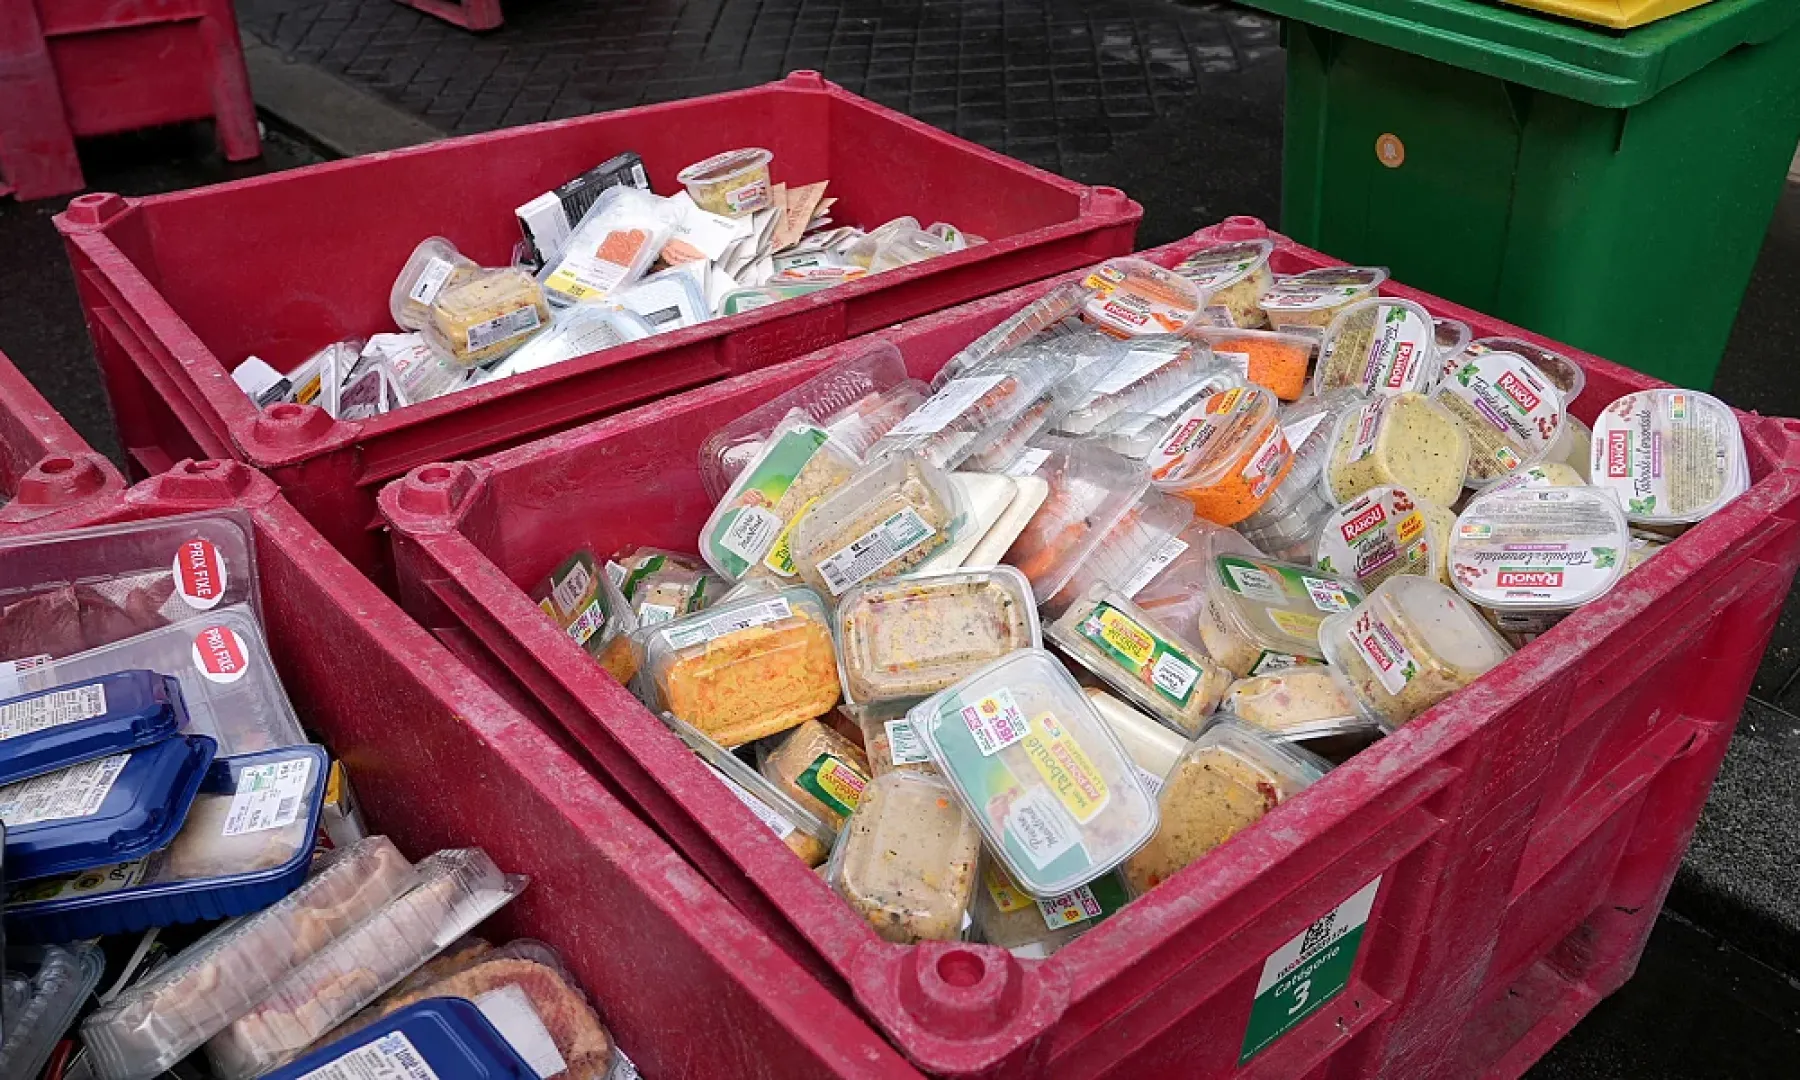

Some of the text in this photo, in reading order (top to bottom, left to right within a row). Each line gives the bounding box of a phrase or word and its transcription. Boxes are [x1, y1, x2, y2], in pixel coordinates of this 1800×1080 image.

[1390, 344, 1412, 385] RANOU
[1501, 374, 1537, 408] RANOU
[1611, 433, 1626, 474] RANOU
[1344, 506, 1382, 539] RANOU
[189, 541, 211, 596] PRIX FIXE
[1501, 573, 1558, 586] RANOU
[204, 628, 235, 672] PRIX FIXE
[1025, 738, 1072, 796] Taboulé
[1274, 946, 1340, 998] Catégorie
[1288, 978, 1312, 1016] 3
